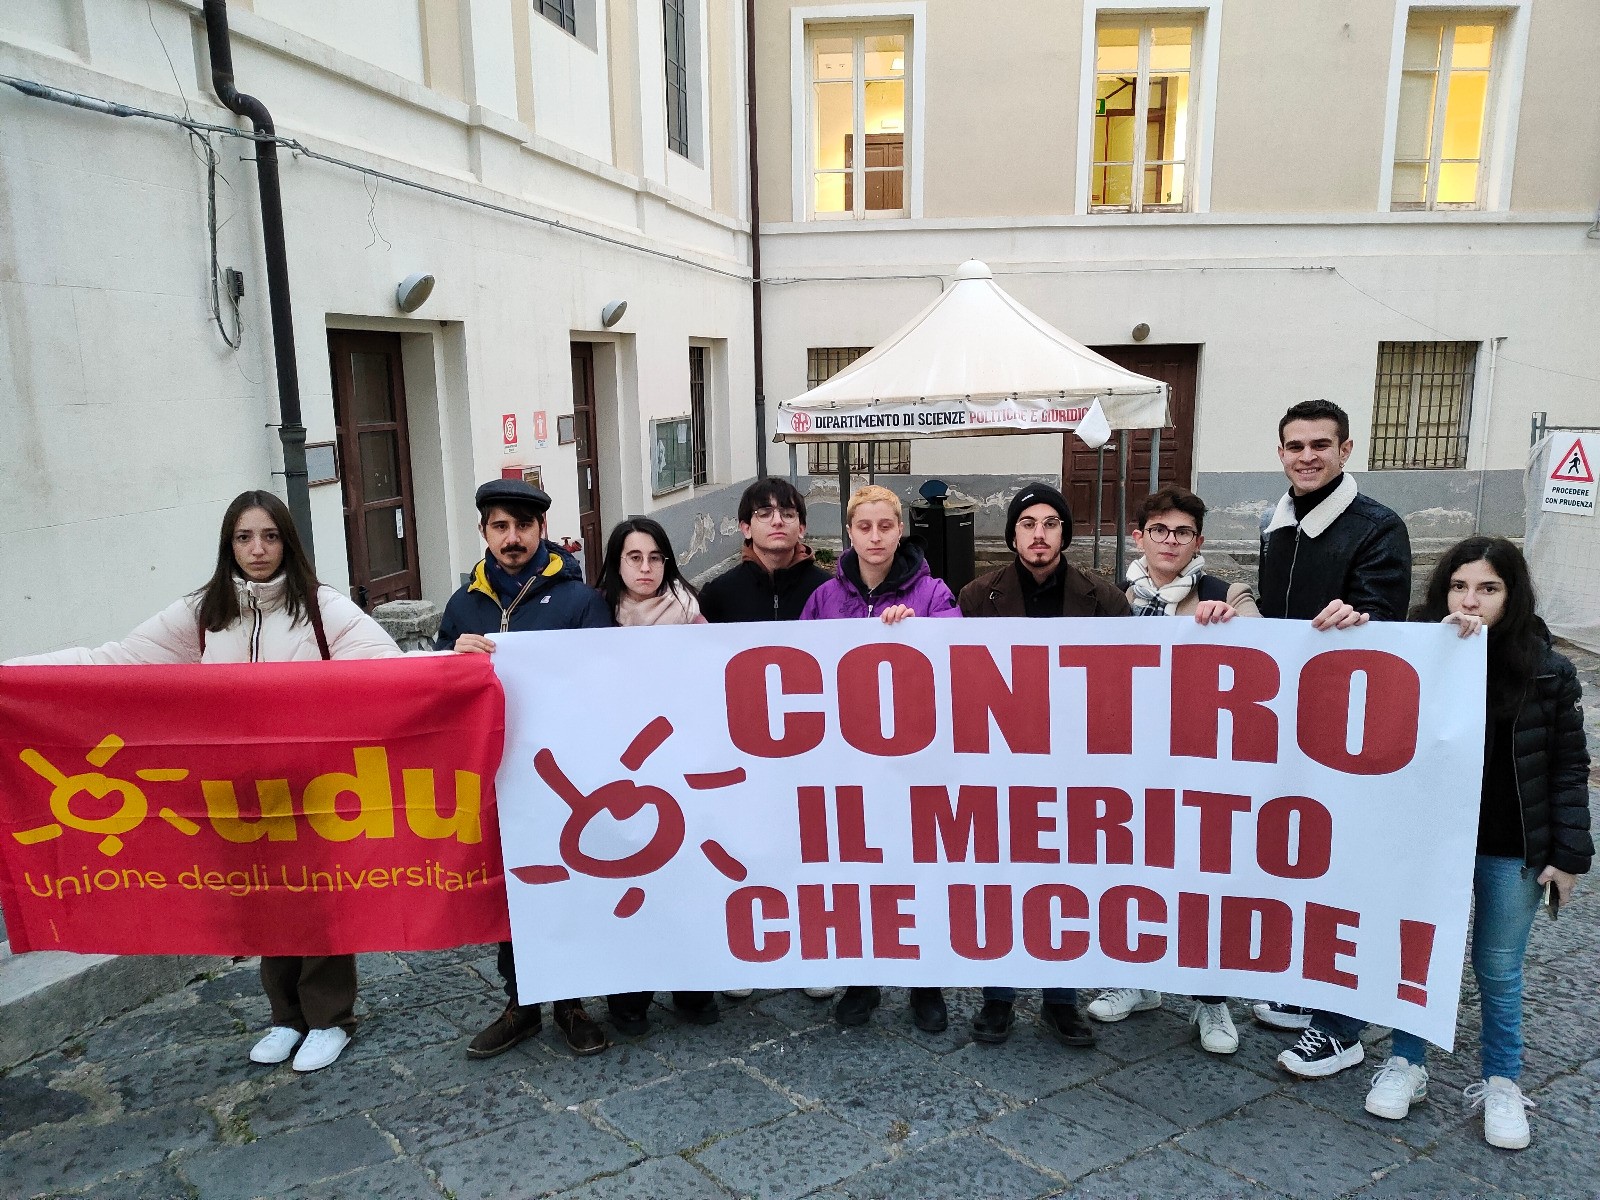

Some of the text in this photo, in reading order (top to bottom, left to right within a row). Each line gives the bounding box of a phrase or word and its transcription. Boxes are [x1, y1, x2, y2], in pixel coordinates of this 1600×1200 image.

[815, 413, 900, 429] DIPARTIMENTO
[903, 413, 915, 426] DI
[918, 411, 966, 426] SCIENZE
[969, 407, 1027, 424] POLITICHE
[1030, 409, 1038, 423] E
[1041, 406, 1090, 423] GIURIDIC
[1545, 497, 1593, 509] CON PRUDENZA
[1551, 486, 1590, 497] PROCEDERE
[725, 643, 1420, 775] CONTRO
[201, 746, 483, 844] udu
[798, 786, 1332, 879] IL MERITO
[24, 860, 488, 899] Unione degli Universitari
[725, 884, 1436, 1007] CHE UCCIDE !
